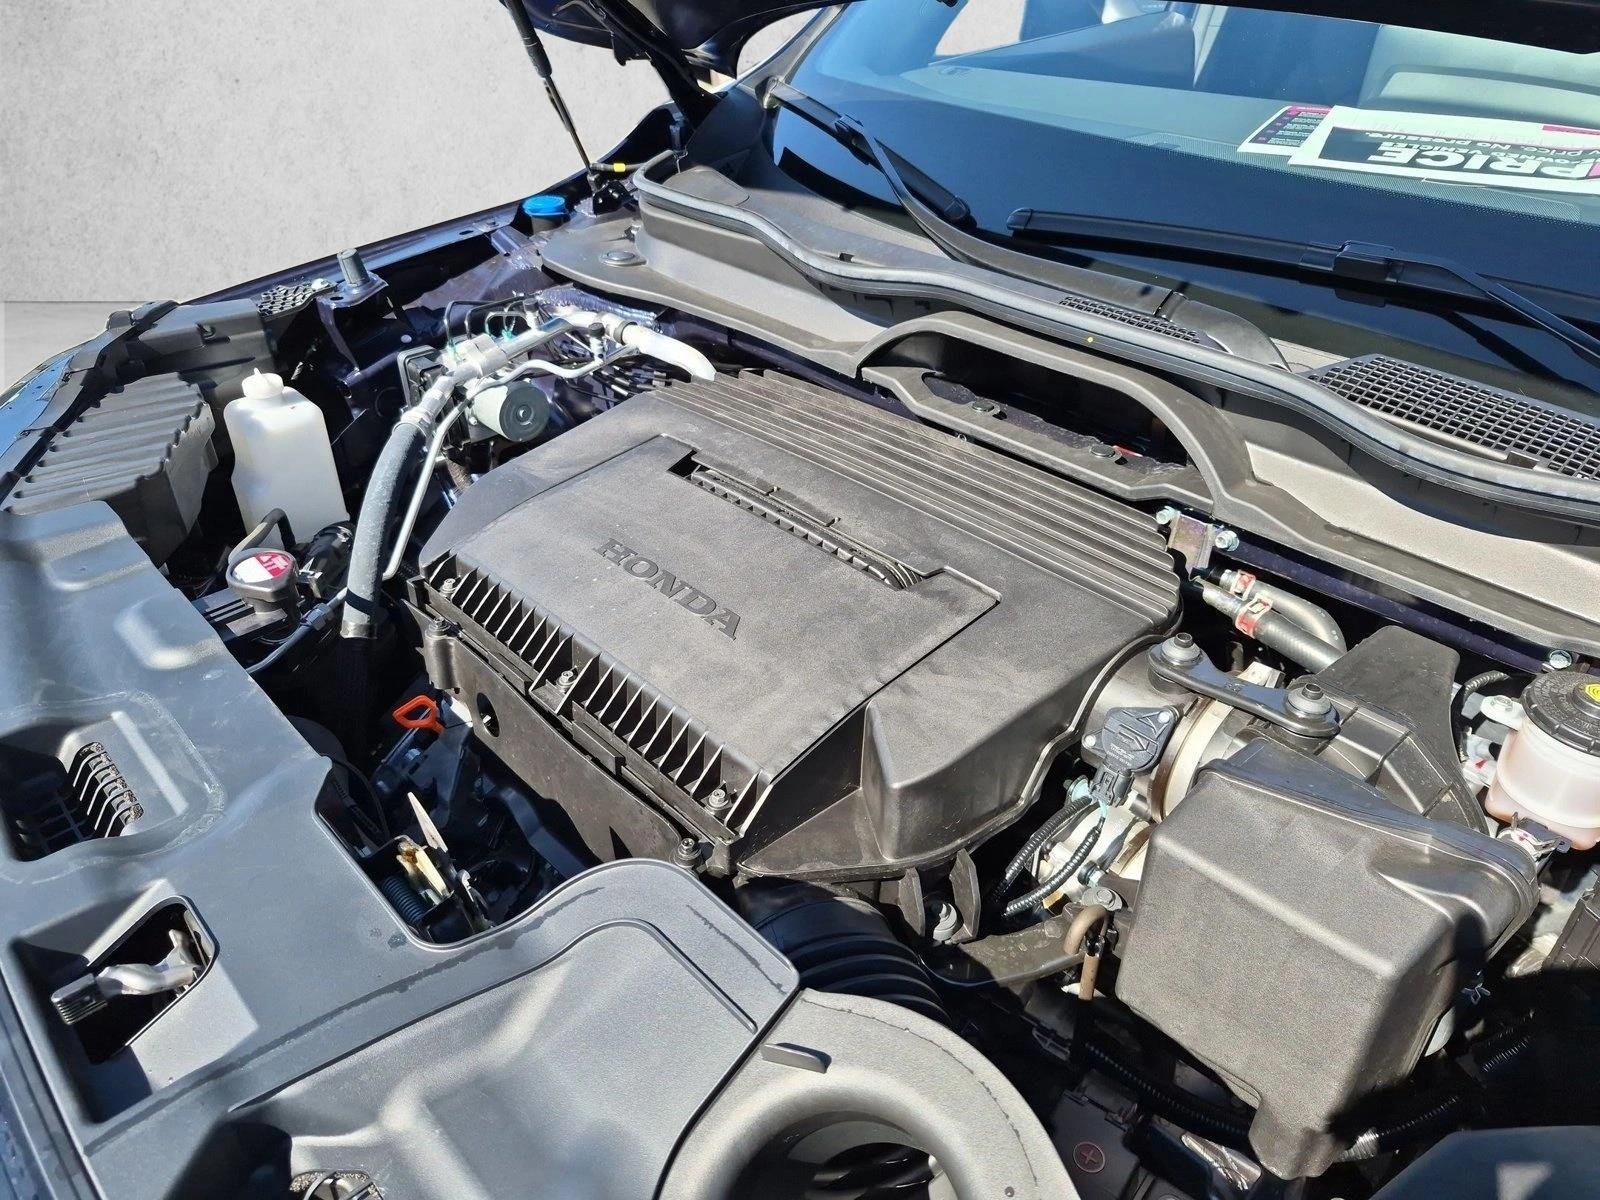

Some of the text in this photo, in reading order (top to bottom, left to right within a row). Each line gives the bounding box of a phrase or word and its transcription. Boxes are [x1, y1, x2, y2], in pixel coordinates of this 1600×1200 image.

[1476, 142, 1512, 150] No
[1367, 147, 1594, 178] PRICE
[594, 538, 741, 641] HONDA
